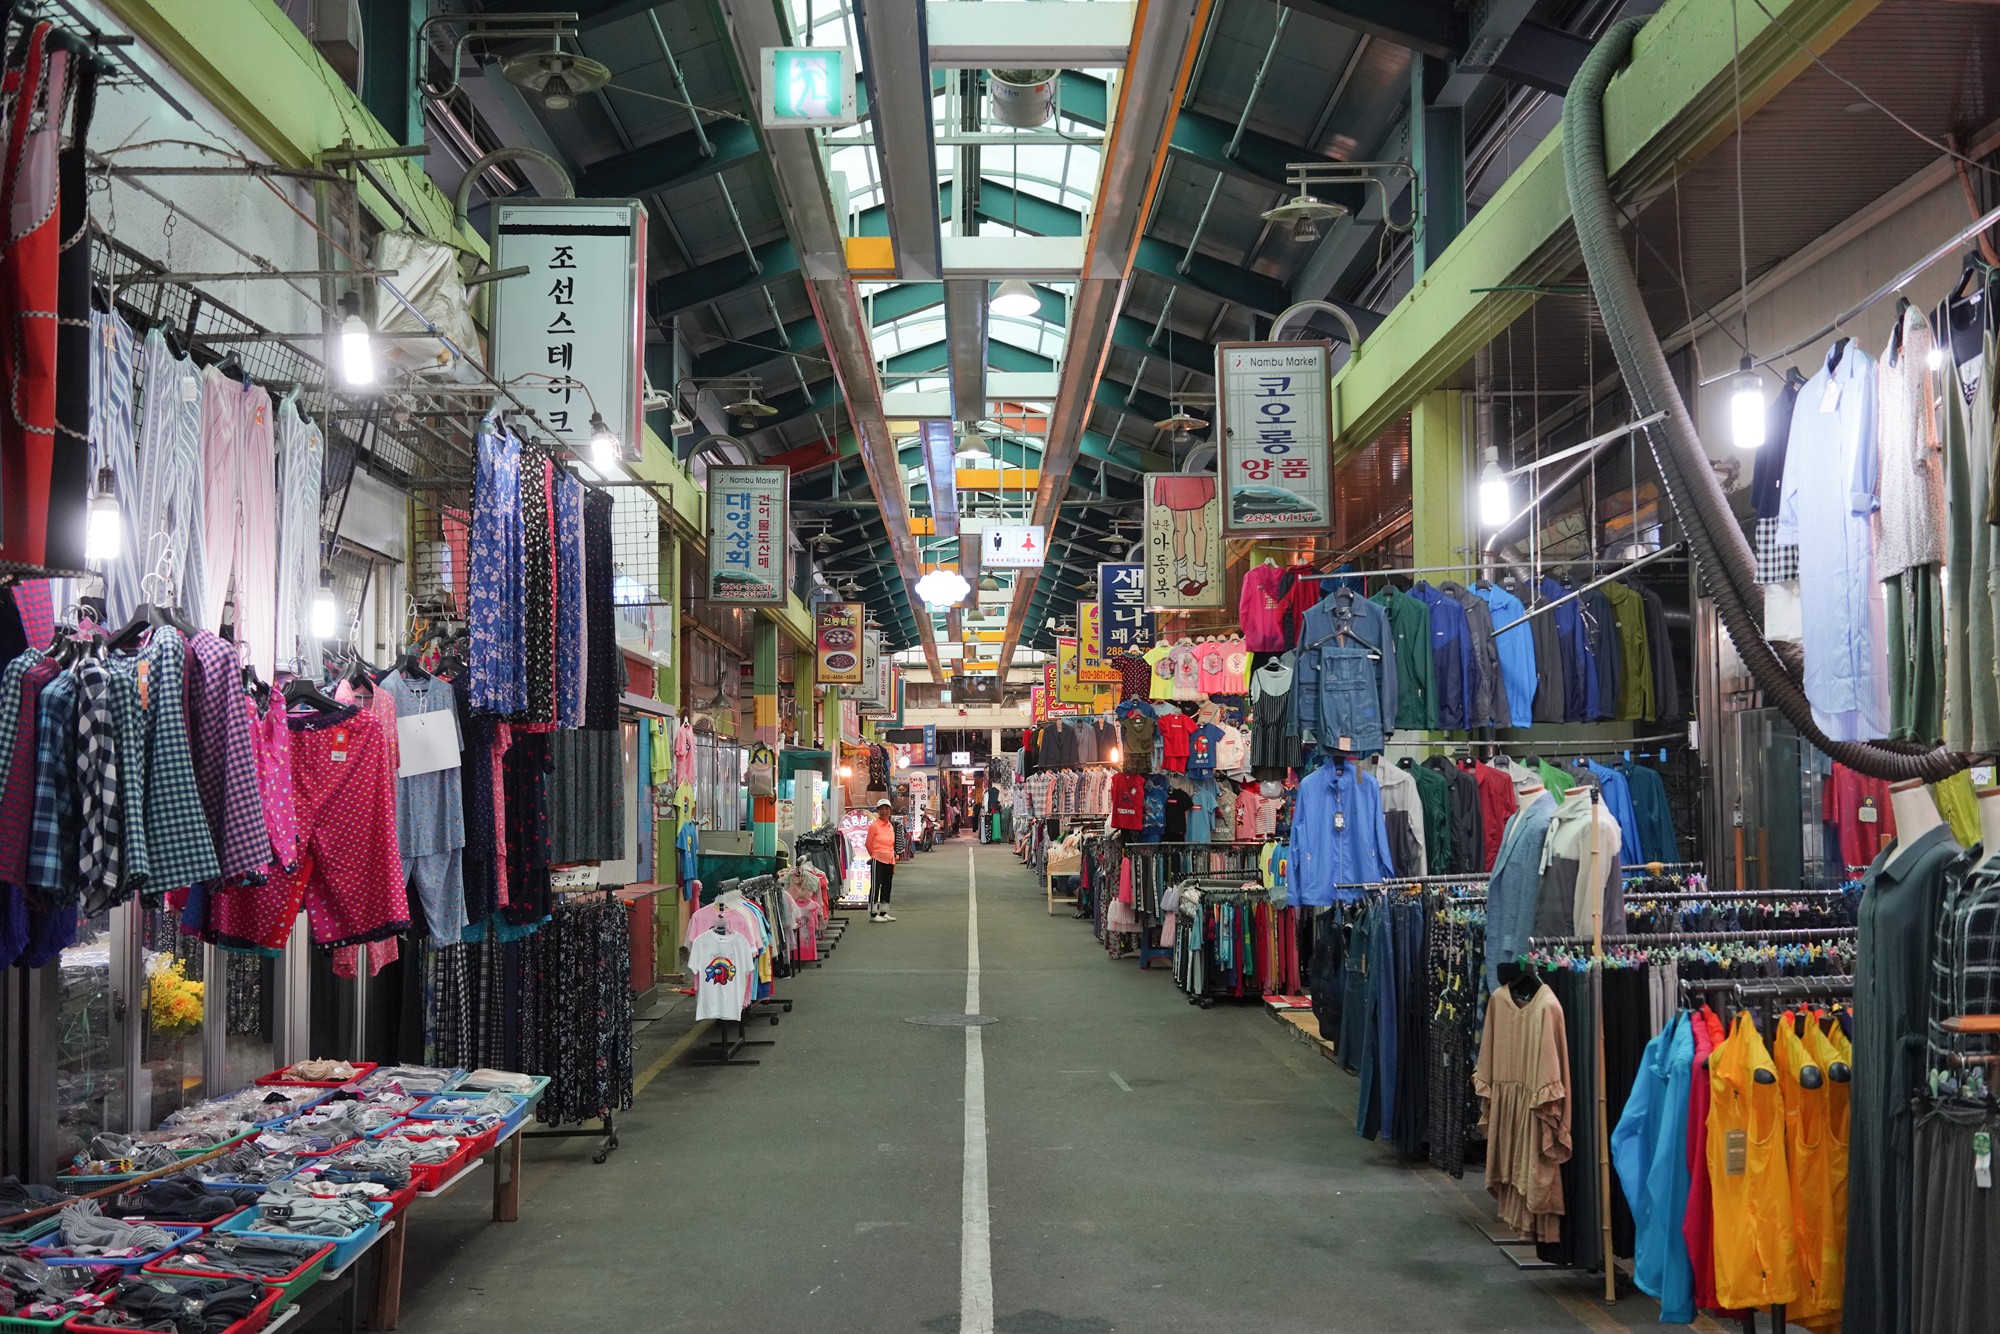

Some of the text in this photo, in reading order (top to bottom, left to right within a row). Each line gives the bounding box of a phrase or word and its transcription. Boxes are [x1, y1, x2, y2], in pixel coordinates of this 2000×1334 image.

[547, 245, 578, 433] 조선스테이크
[1250, 355, 1317, 367] Nambu Market
[1254, 376, 1298, 455] 코오롱
[729, 476, 779, 485] Nambu Market
[1241, 458, 1311, 481] 양품
[1244, 512, 1314, 523] 288-0117
[725, 492, 754, 569] 대영상회
[1153, 532, 1170, 598] 아동복
[1110, 628, 1149, 644] 패션
